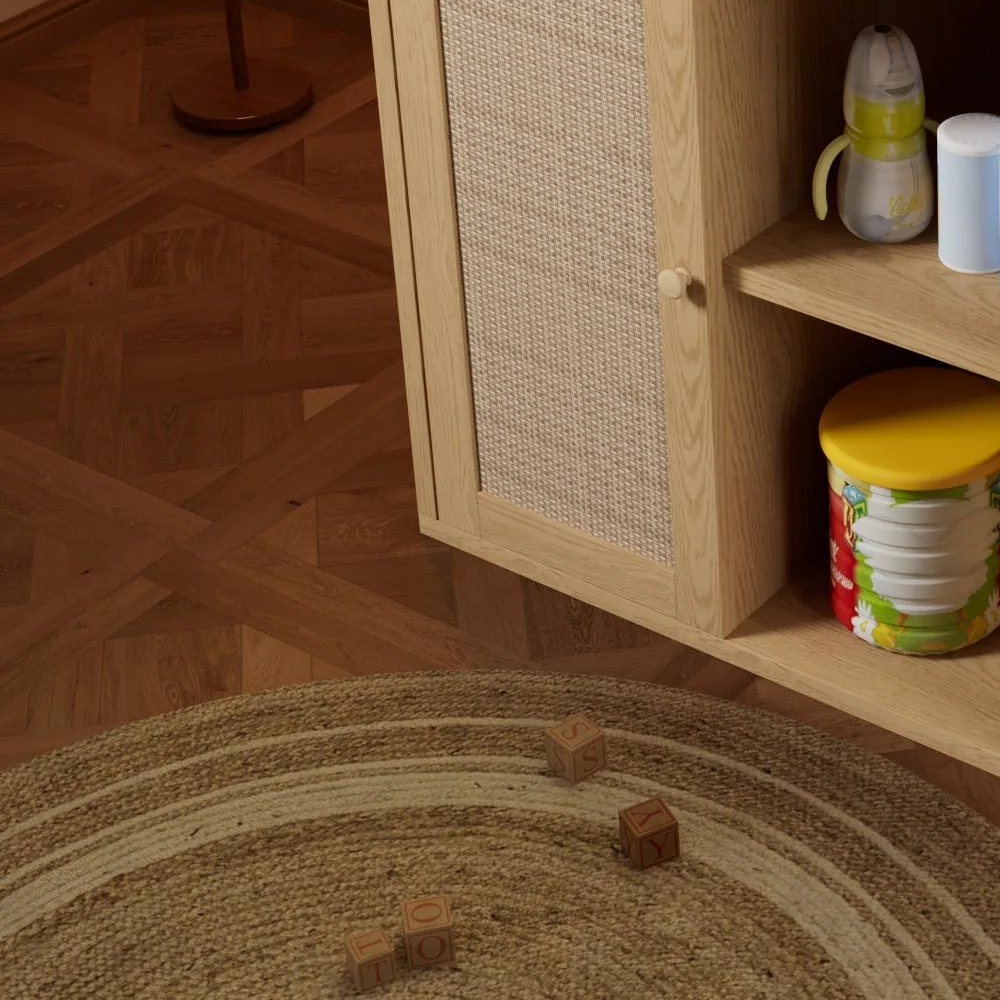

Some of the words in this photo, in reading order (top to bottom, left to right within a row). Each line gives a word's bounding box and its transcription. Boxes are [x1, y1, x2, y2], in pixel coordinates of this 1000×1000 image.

[582, 744, 598, 772] S
[647, 832, 672, 860] Y
[411, 902, 443, 923] O
[417, 935, 446, 960] O
[368, 960, 387, 982] T
